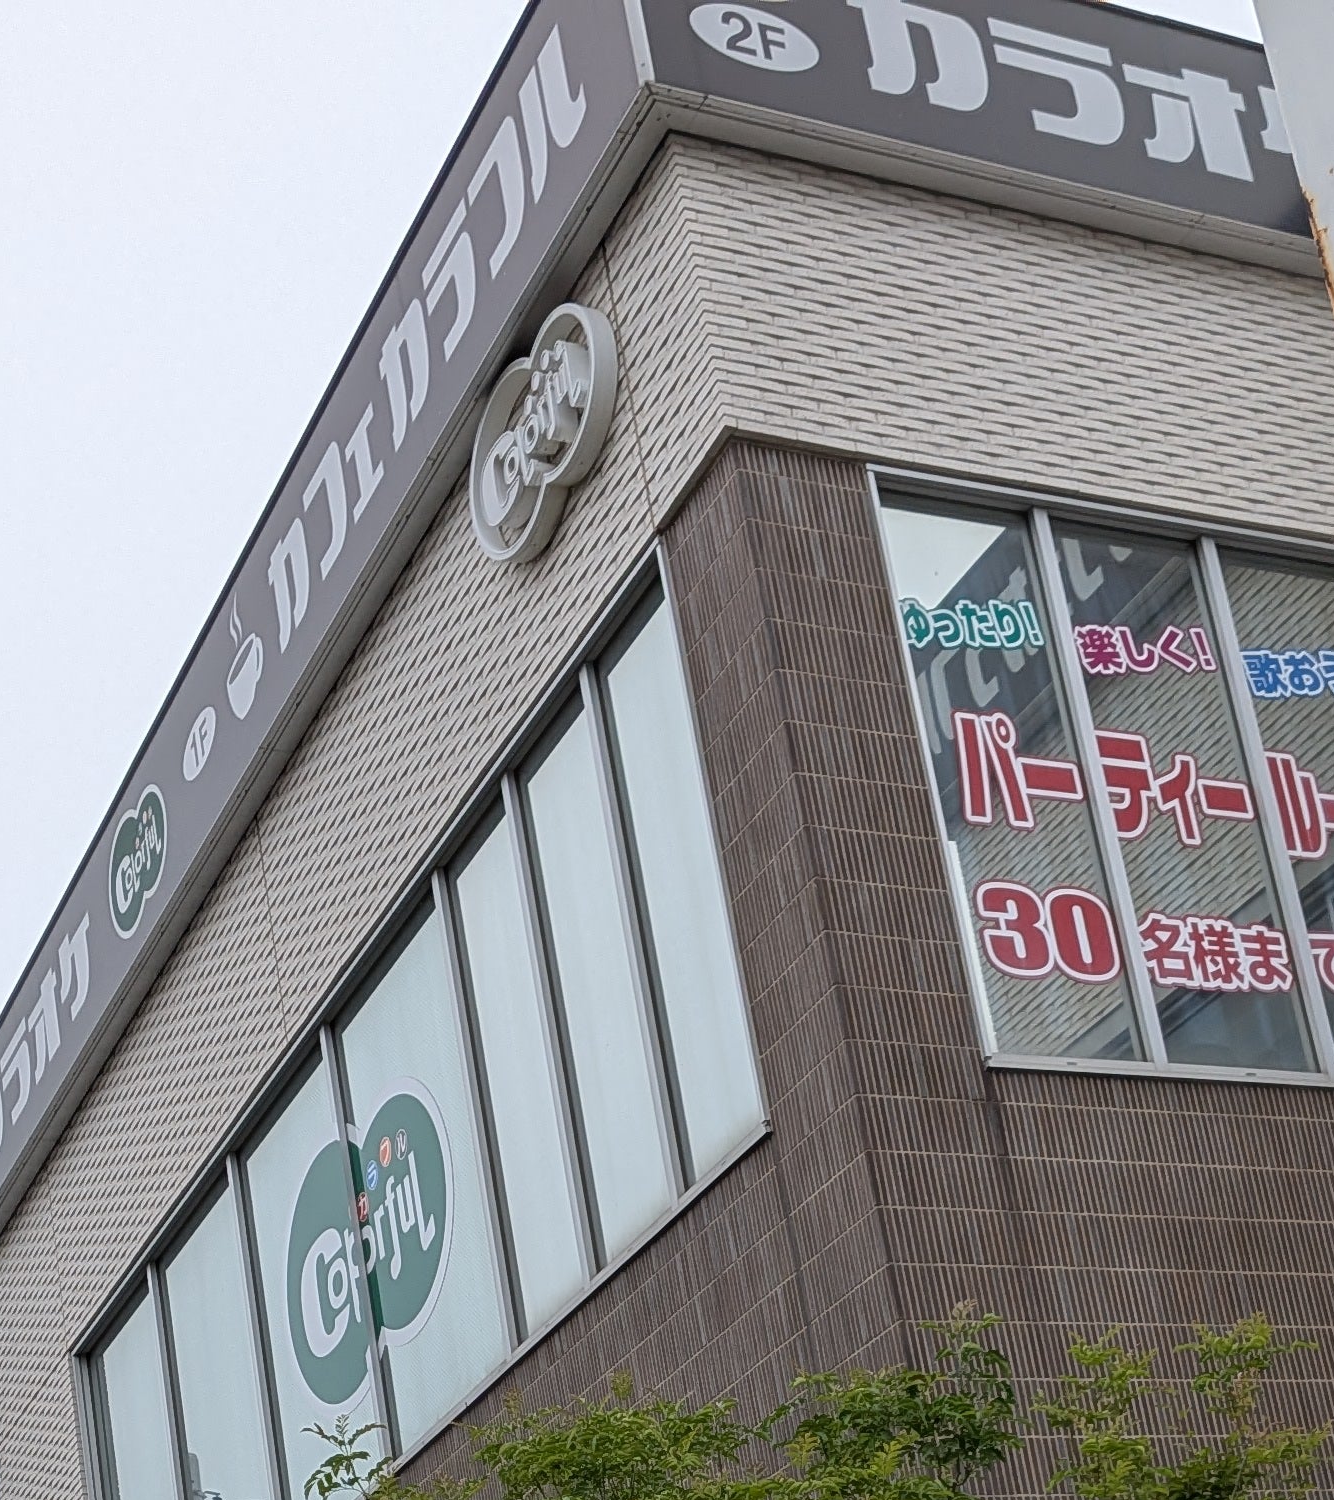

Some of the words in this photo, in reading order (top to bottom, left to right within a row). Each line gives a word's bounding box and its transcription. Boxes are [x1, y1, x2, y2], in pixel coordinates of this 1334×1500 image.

[724, 11, 786, 61] 2F
[846, 0, 1294, 182] カラオ
[267, 23, 587, 654] カフェカラフル
[482, 340, 585, 527] Colorful
[1075, 625, 1217, 674] 楽しく!
[191, 717, 208, 768] 1F
[115, 814, 162, 914] Colorful
